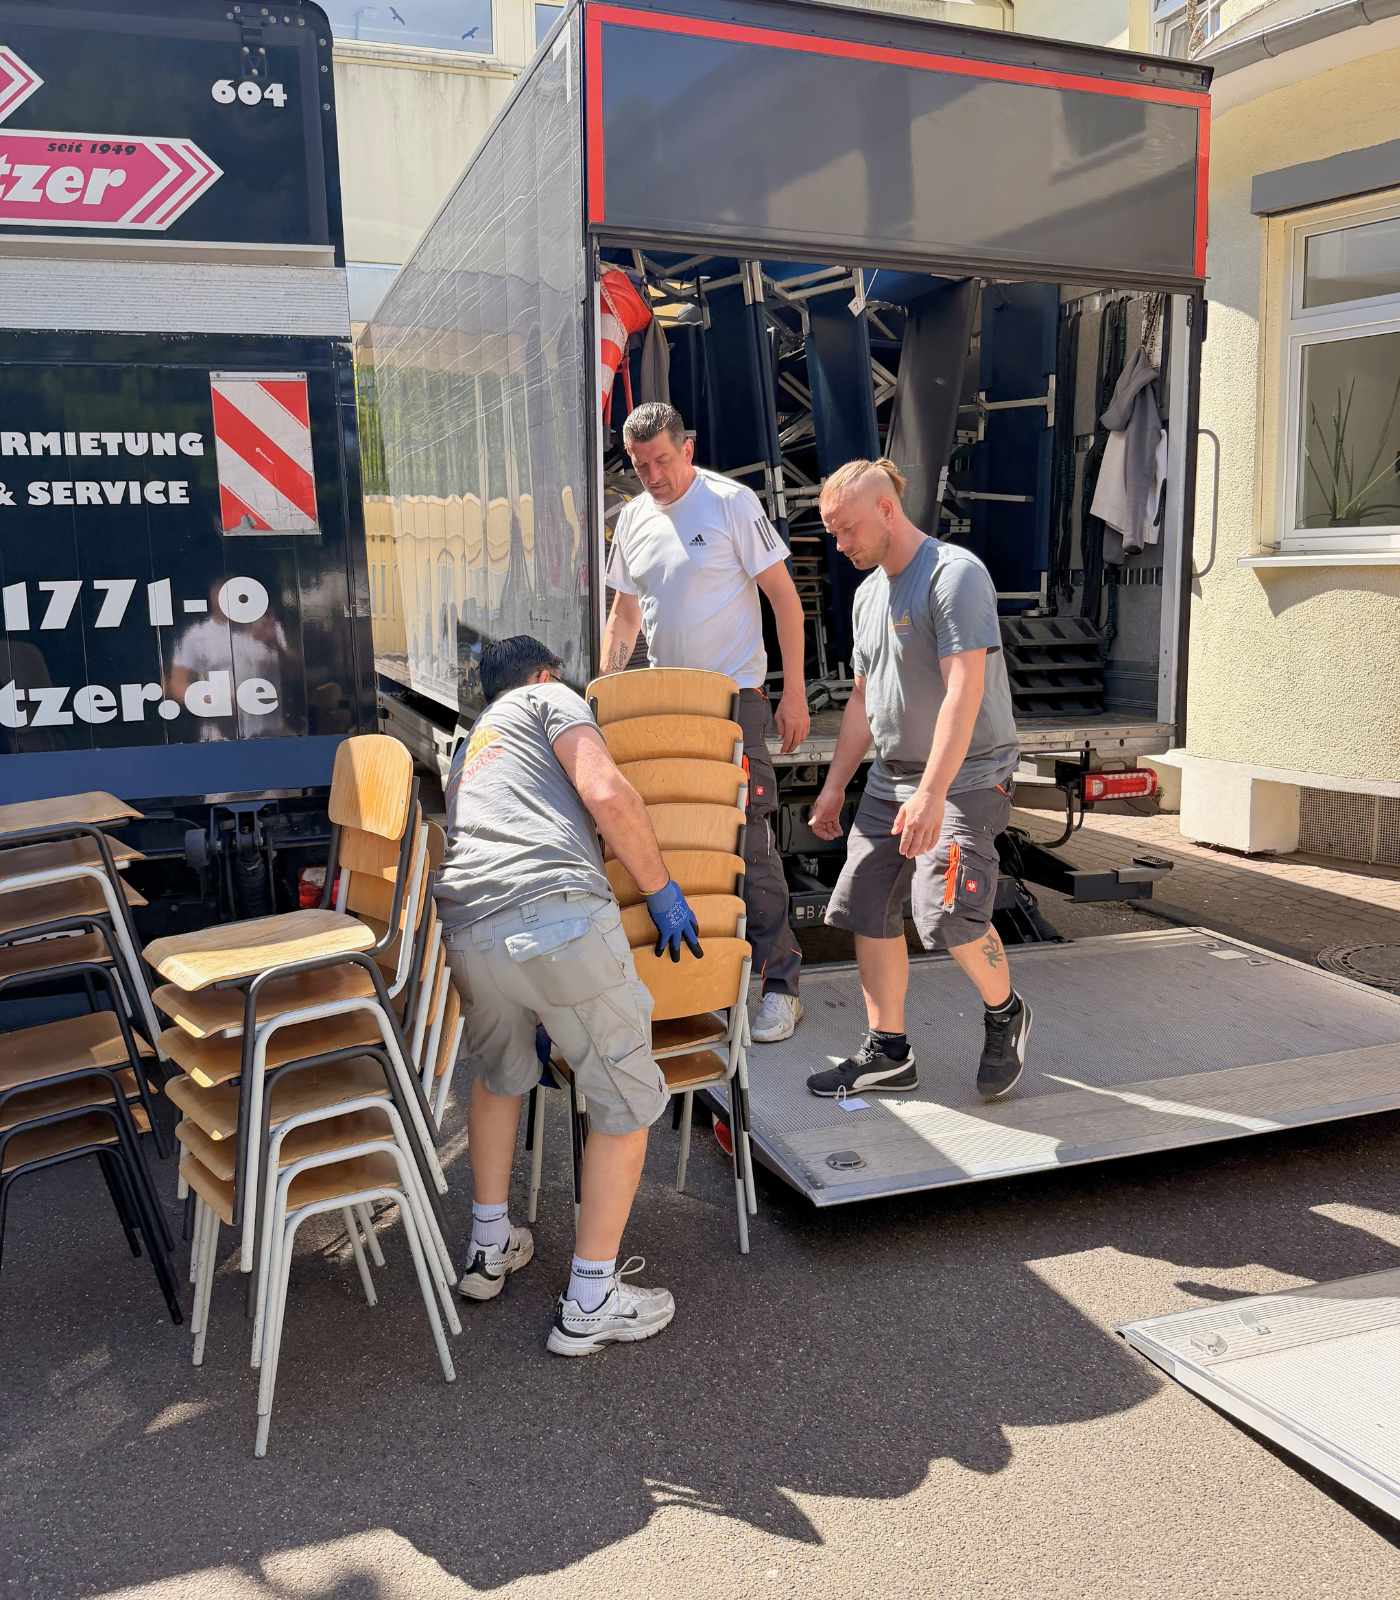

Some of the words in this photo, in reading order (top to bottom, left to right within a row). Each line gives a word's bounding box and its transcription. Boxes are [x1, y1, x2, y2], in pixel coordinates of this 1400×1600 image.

[211, 79, 287, 107] 604
[47, 141, 83, 153] seit
[90, 143, 136, 155] 1949
[0, 153, 126, 204] zer
[0, 432, 204, 456] RMIETUNG
[28, 481, 190, 505] SERVICE
[0, 671, 278, 728] tzer.de
